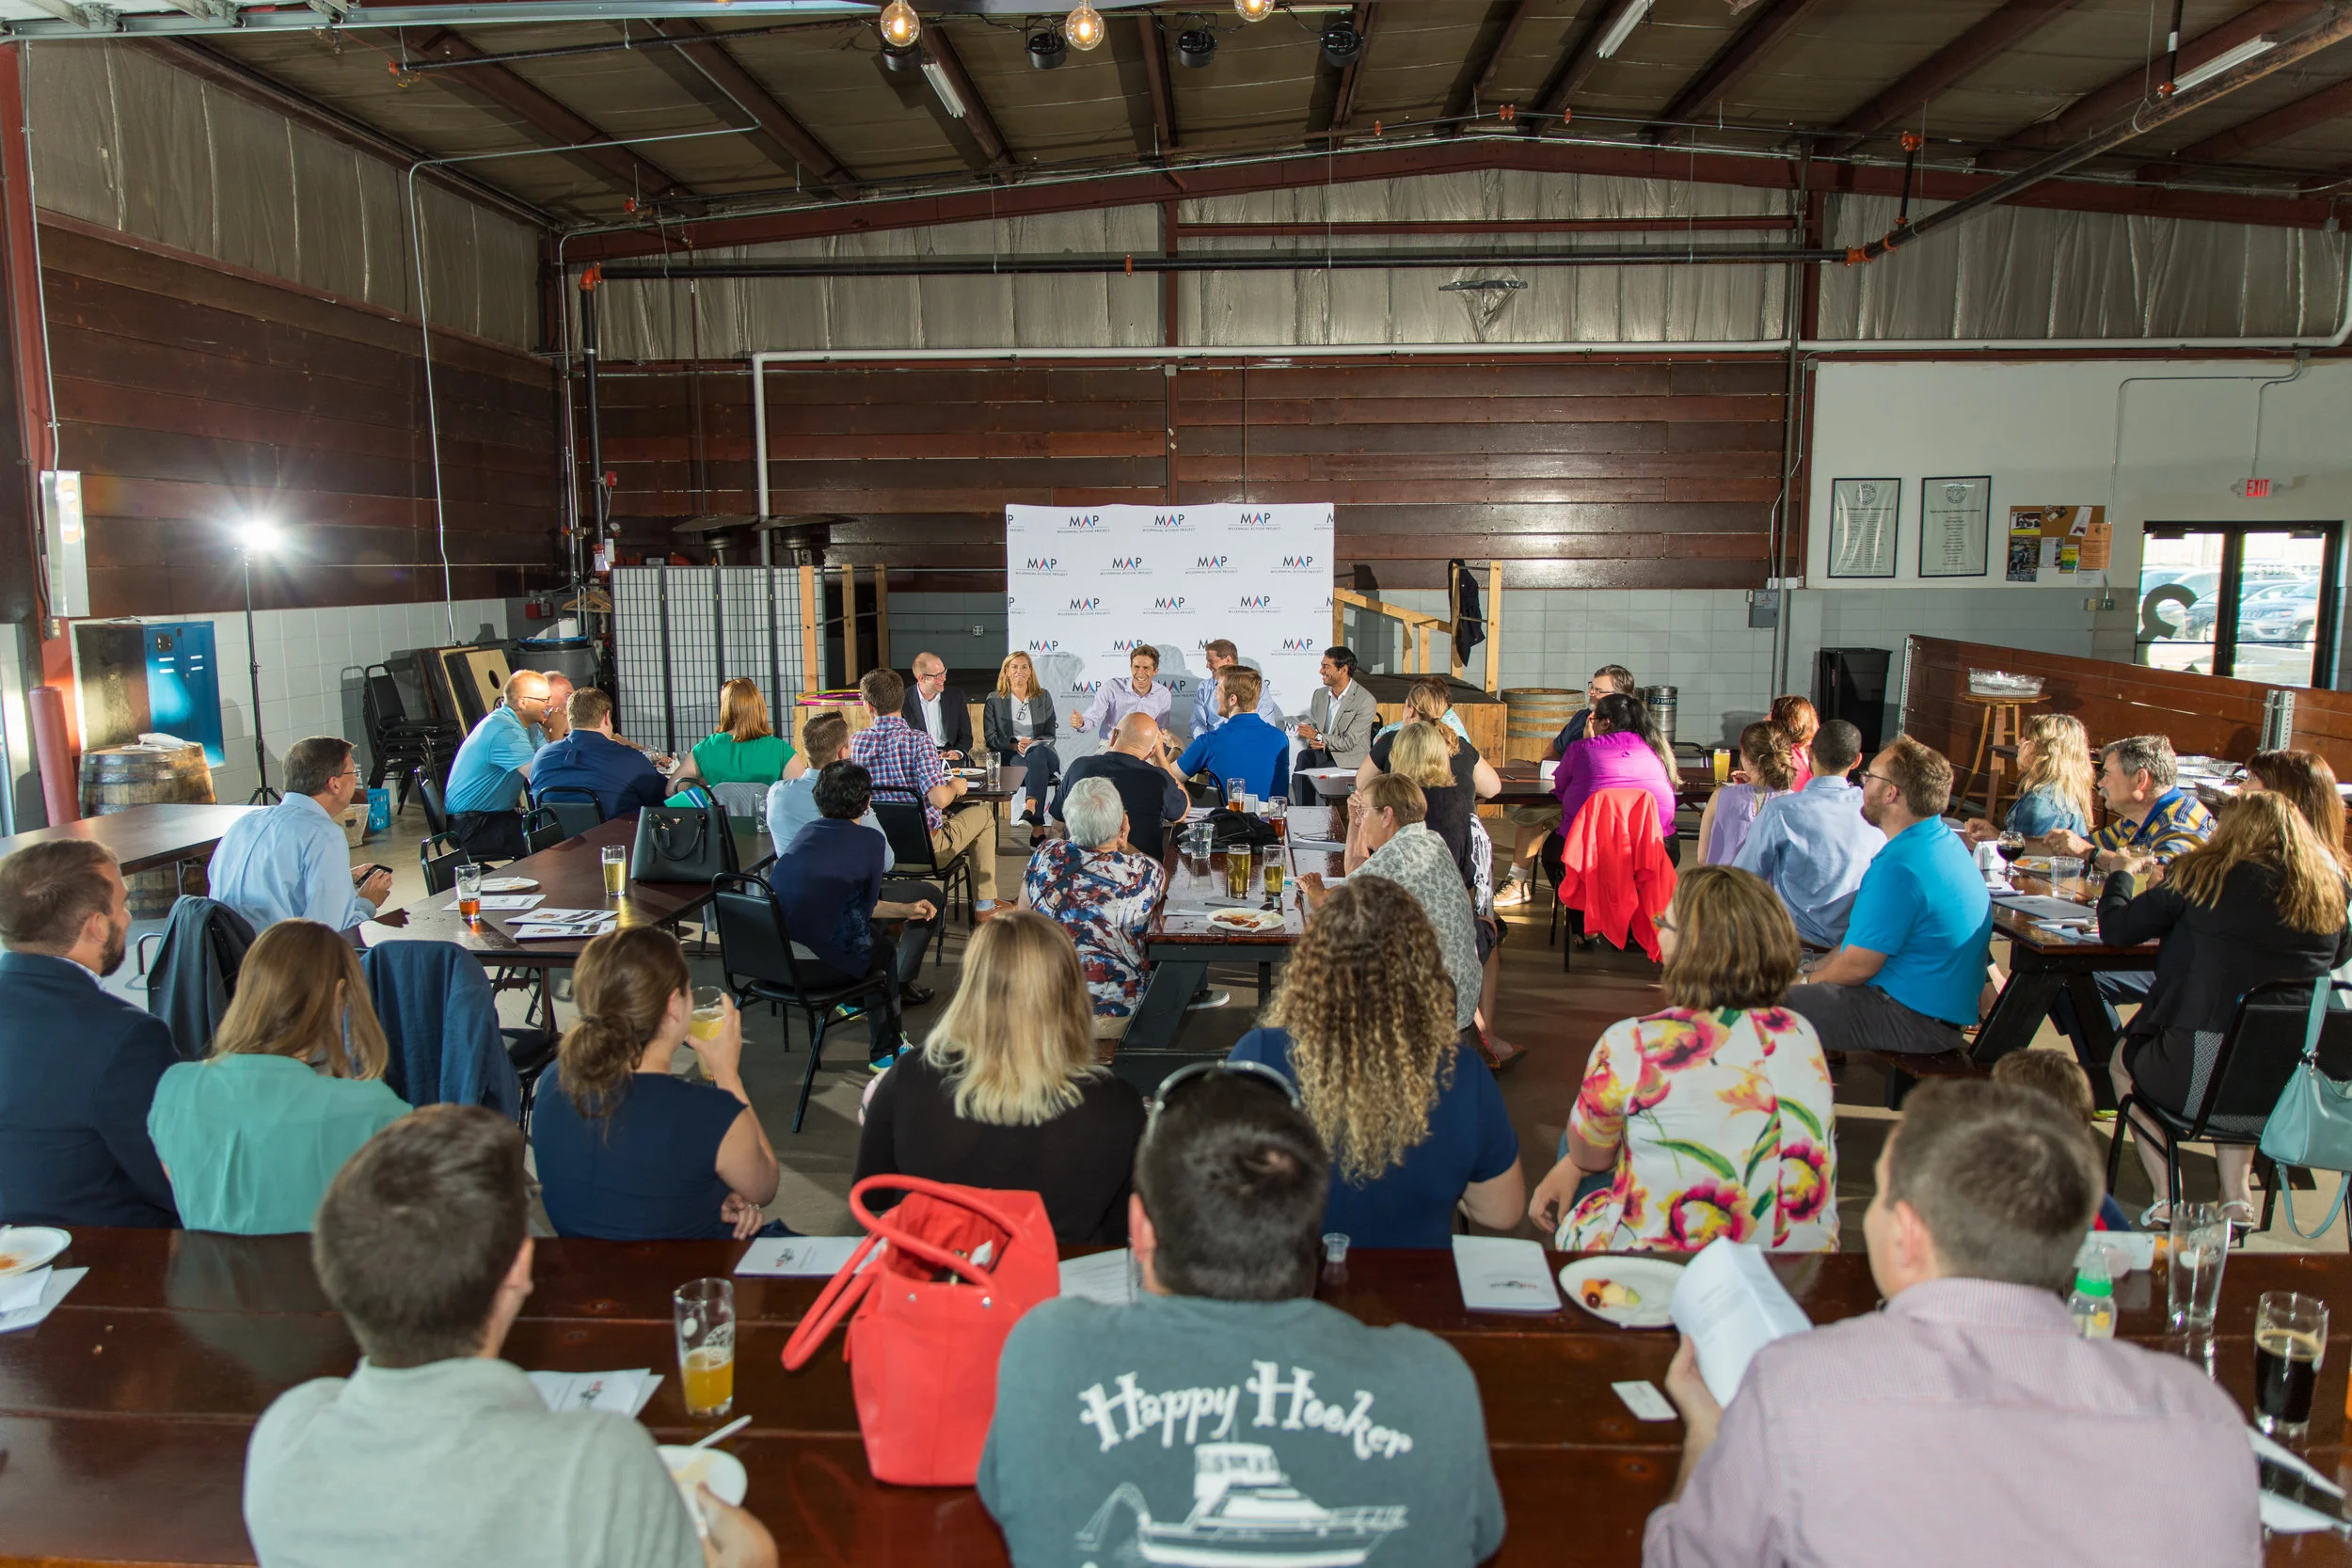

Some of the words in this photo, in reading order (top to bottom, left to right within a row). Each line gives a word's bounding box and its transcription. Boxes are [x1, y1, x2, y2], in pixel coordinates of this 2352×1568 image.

[2246, 479, 2269, 498] EXIT
[1070, 515, 1099, 530] MAP
[1154, 514, 1184, 529] MAP
[1241, 512, 1270, 527] MAP
[1027, 558, 1057, 572] MAP
[1112, 557, 1142, 572] MAP
[1198, 555, 1227, 570] MAP
[1283, 555, 1312, 570] MAP
[1070, 597, 1100, 612] MAP
[1155, 596, 1184, 611] MAP
[1241, 595, 1270, 610] MAP
[1029, 640, 1058, 655] MAP
[1114, 640, 1142, 655] MAP
[1283, 638, 1312, 653] MAP
[1073, 681, 1102, 694] MAP
[1078, 1370, 1240, 1453] Happy
[1246, 1360, 1413, 1460] Hooker
